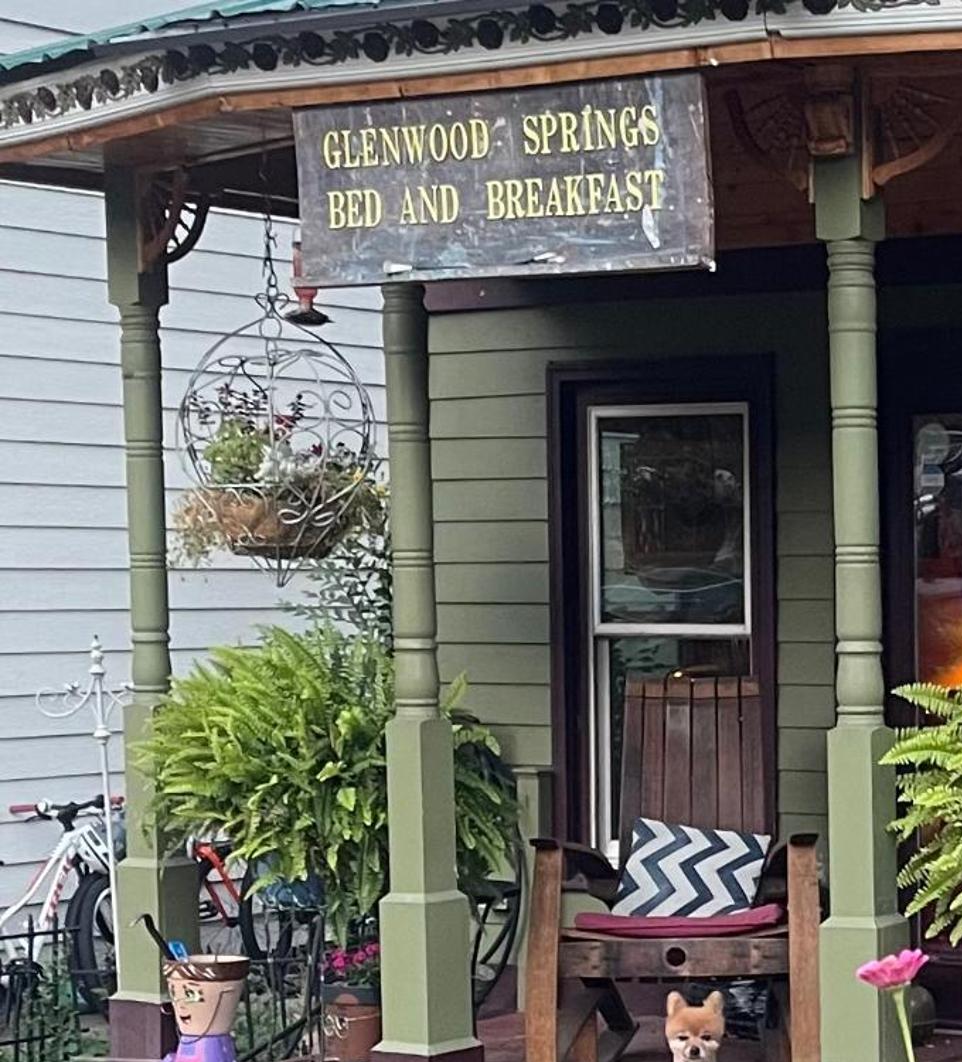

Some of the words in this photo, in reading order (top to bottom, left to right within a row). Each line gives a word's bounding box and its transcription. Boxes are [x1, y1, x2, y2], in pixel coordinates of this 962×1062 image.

[322, 119, 490, 170] GLENWOOD
[522, 104, 660, 156] SPRINGS
[327, 188, 383, 230] BED
[400, 184, 460, 226] AND
[486, 169, 665, 221] BREAKFAST
